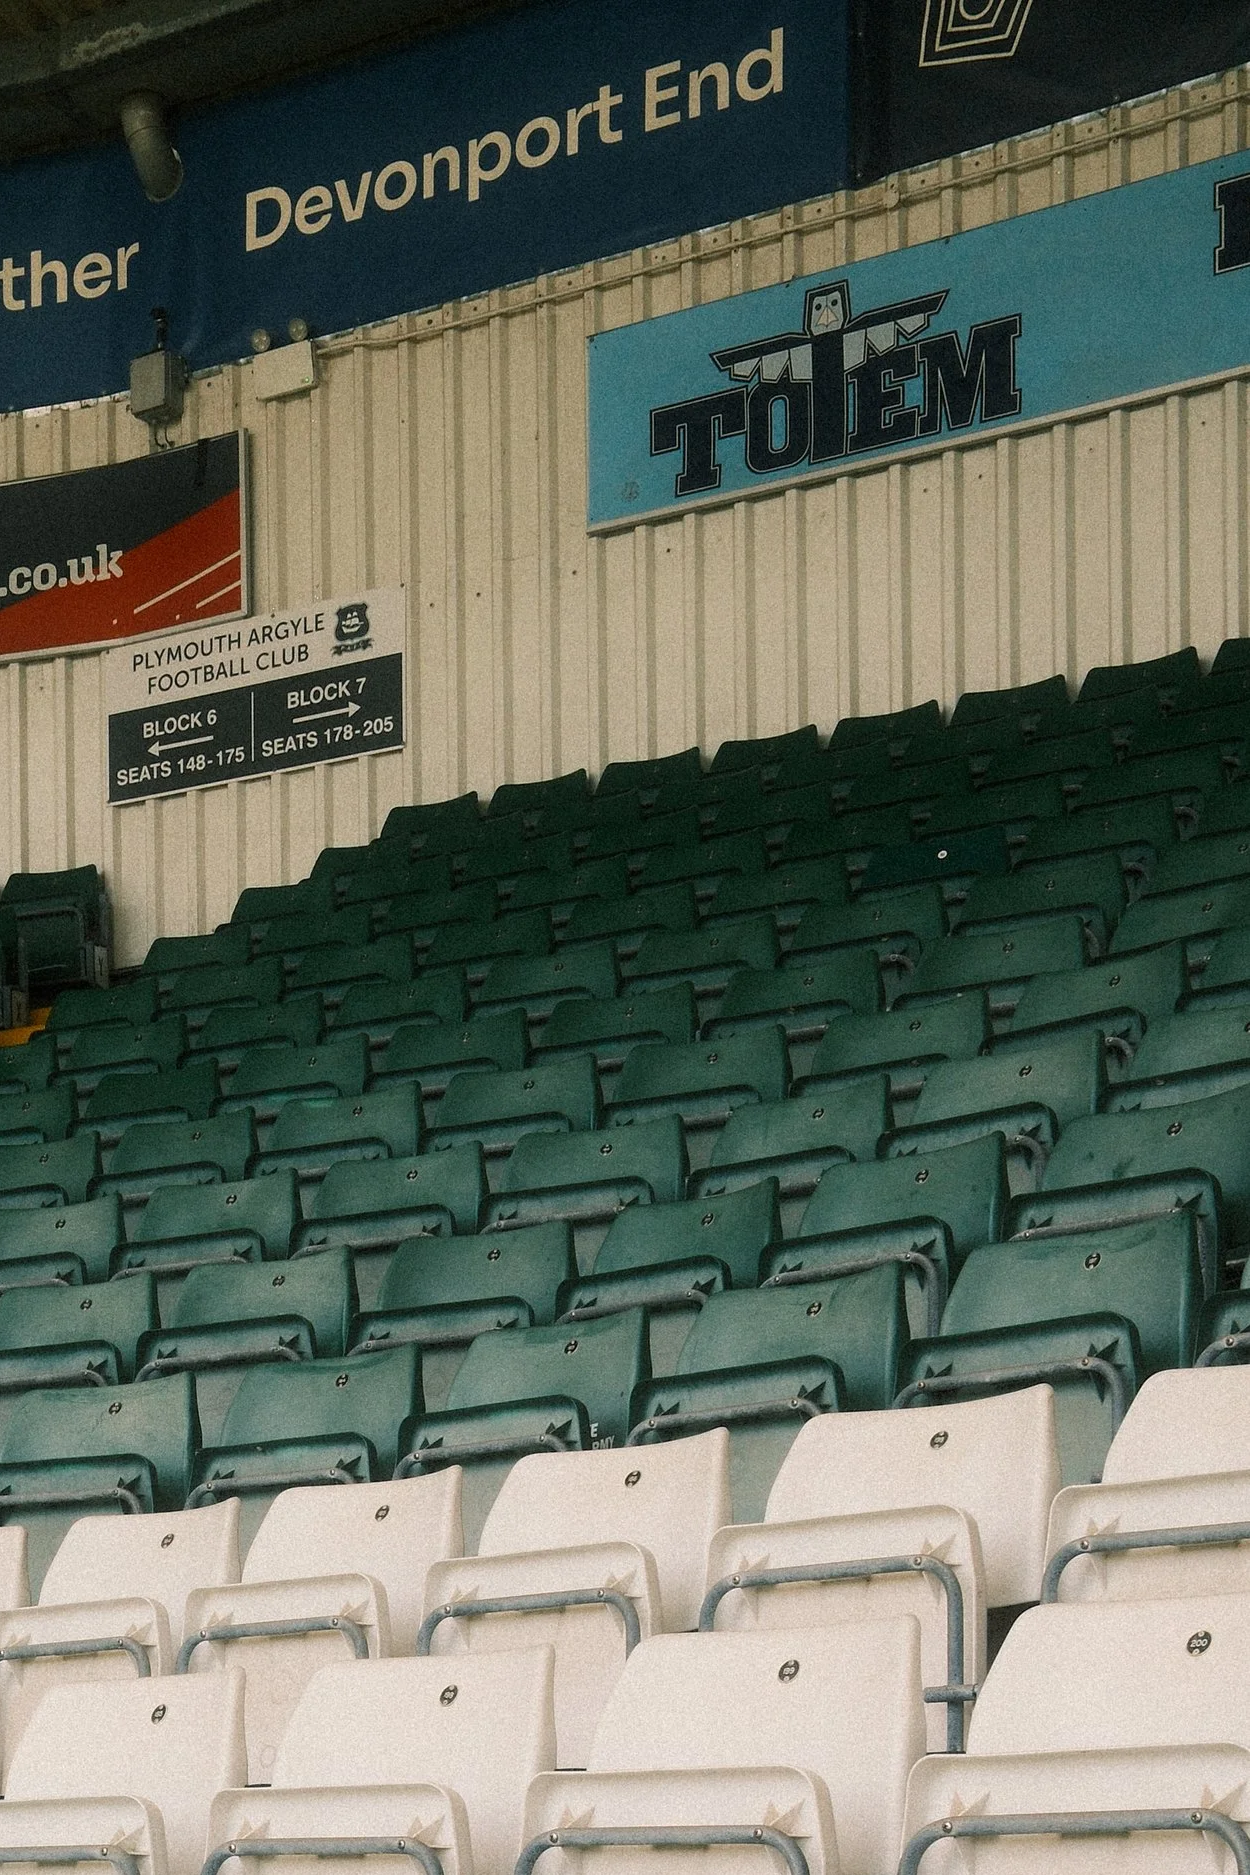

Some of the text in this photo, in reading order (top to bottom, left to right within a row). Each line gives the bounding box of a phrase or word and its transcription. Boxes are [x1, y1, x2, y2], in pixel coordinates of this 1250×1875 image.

[245, 28, 784, 252] Devonport End
[132, 631, 242, 672] PLYMOUTH
[247, 612, 325, 648] ARGYLE
[147, 657, 250, 695] FOOTBALL
[256, 643, 310, 671] CLUB
[287, 677, 367, 710] BLOCK 7
[142, 708, 218, 739] BLOCK 6
[261, 731, 319, 758] SEATS
[116, 759, 172, 787] SEATS
[1189, 1637, 1209, 1649] 200
